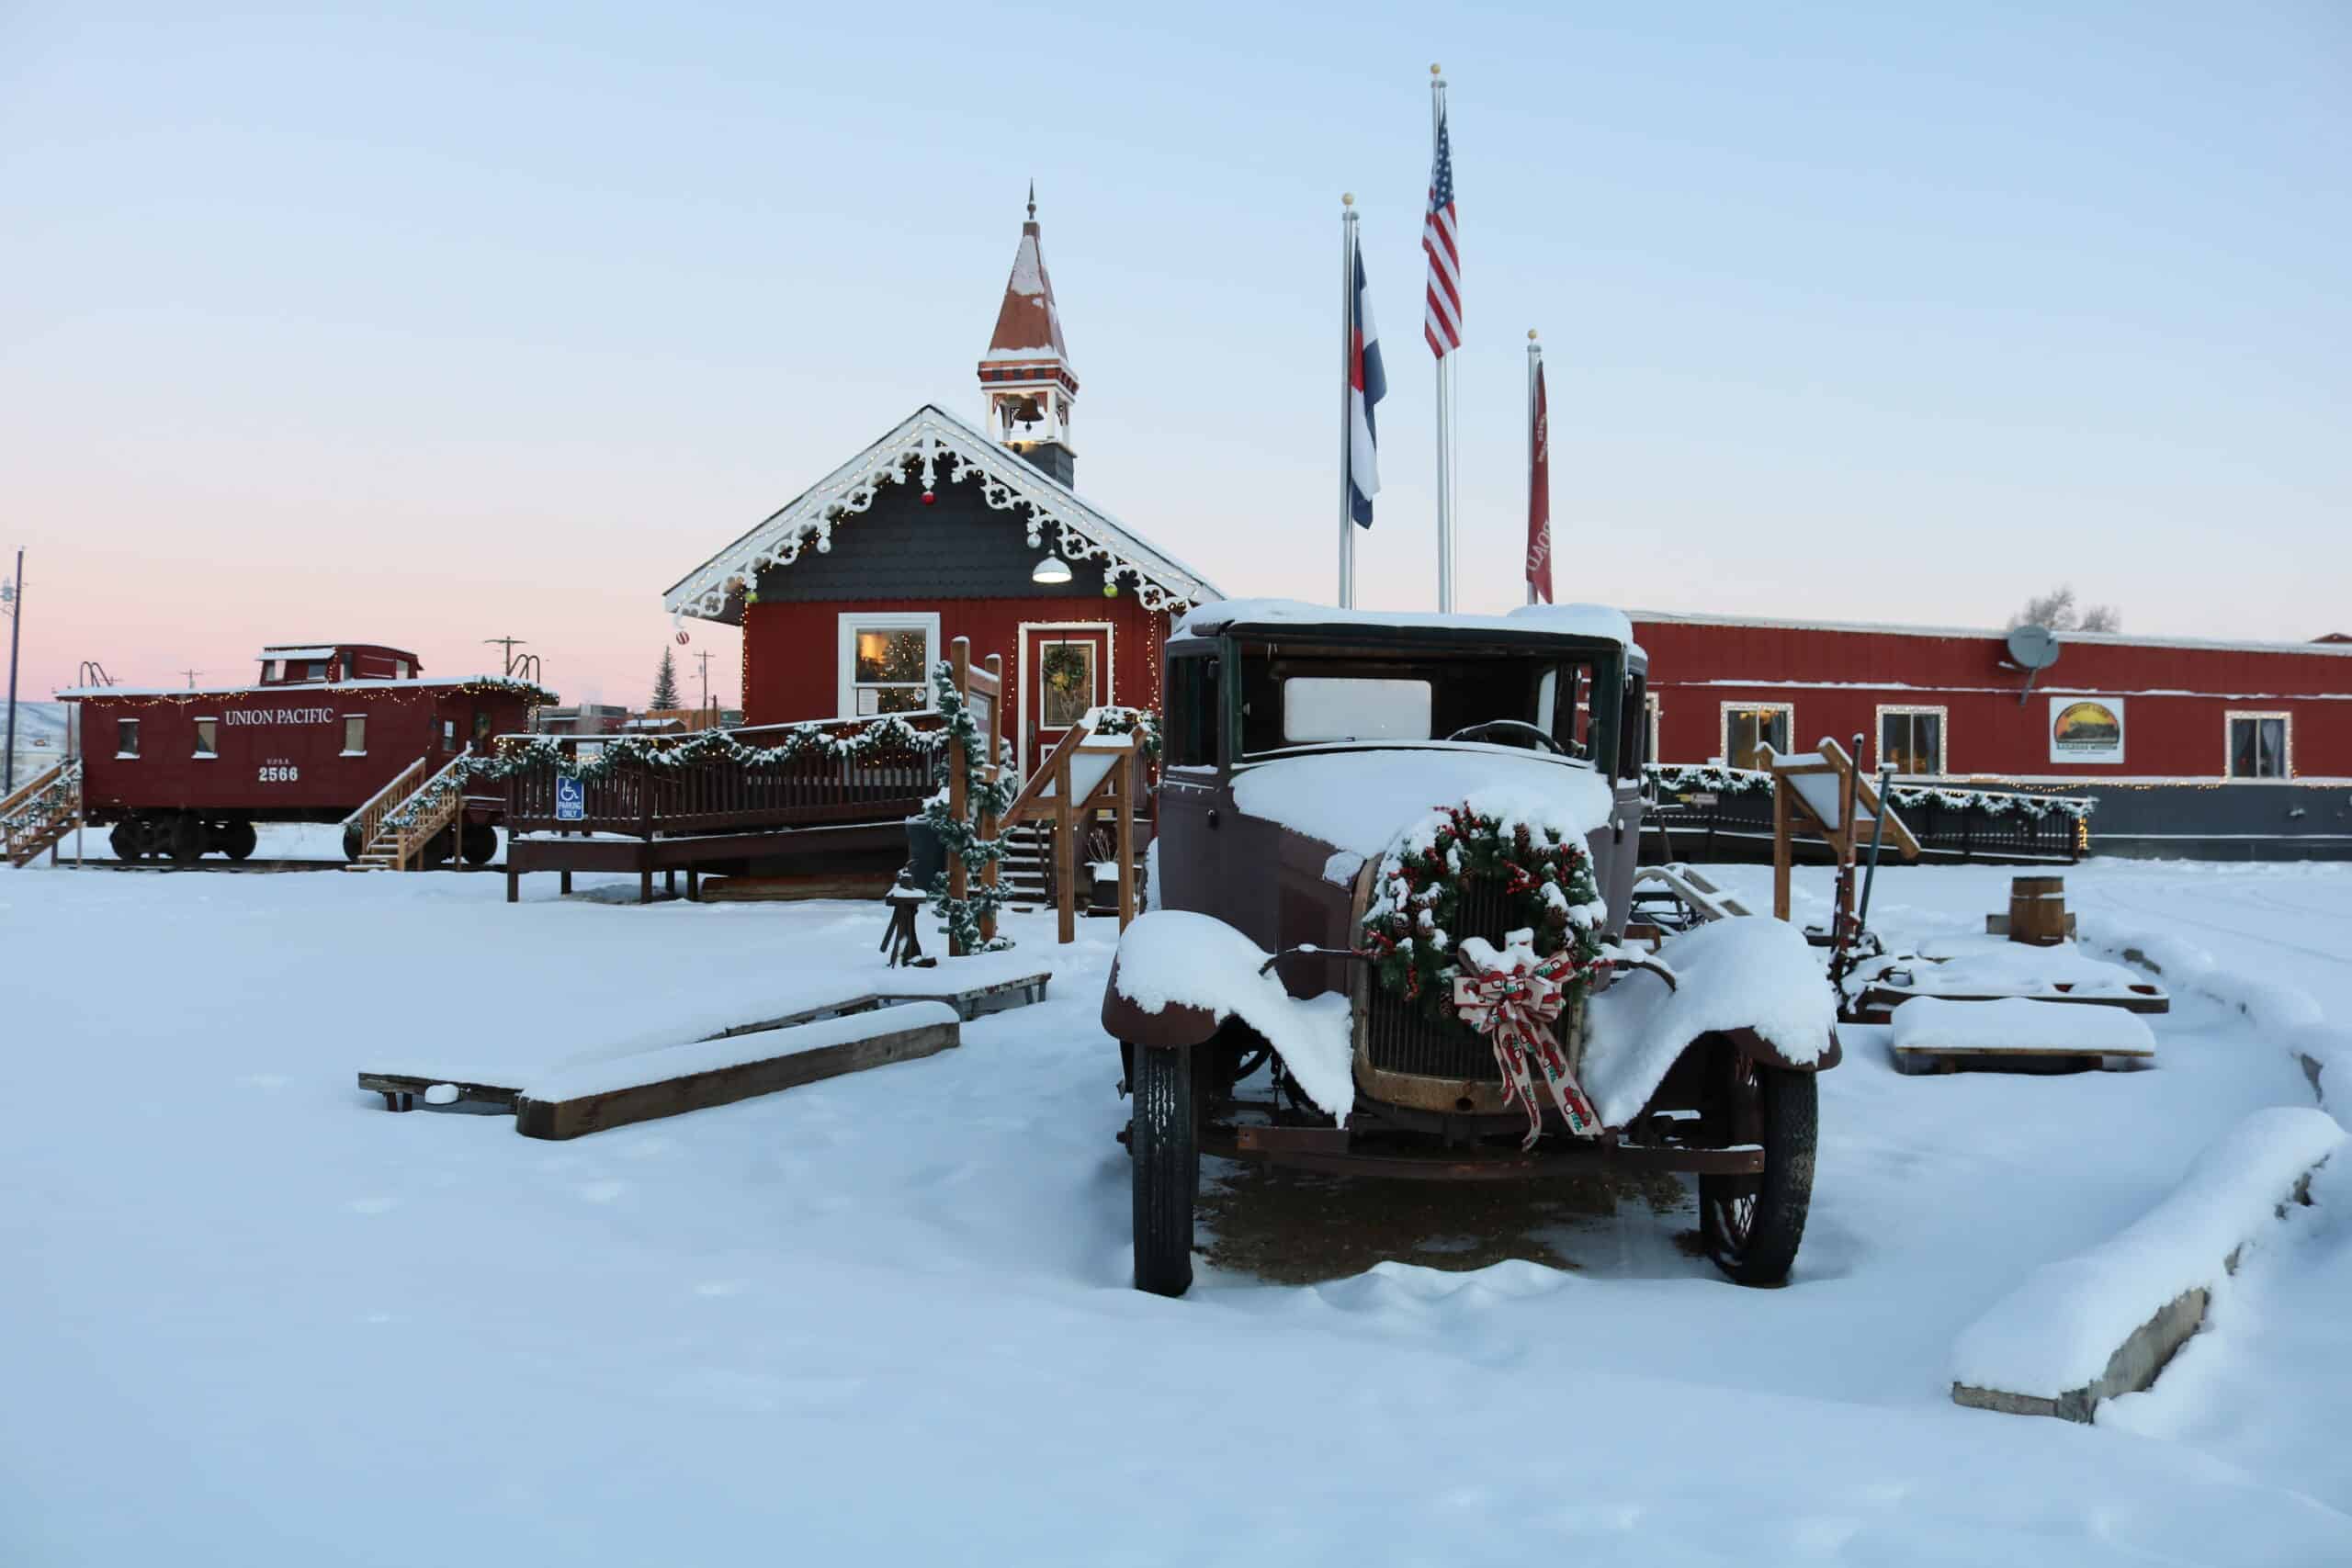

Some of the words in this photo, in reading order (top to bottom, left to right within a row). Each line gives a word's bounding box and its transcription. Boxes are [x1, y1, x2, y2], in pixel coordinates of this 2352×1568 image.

[225, 710, 273, 726] UNION
[277, 707, 334, 724] PACIFIC
[258, 767, 298, 782] 2566
[559, 801, 581, 809] PARKING
